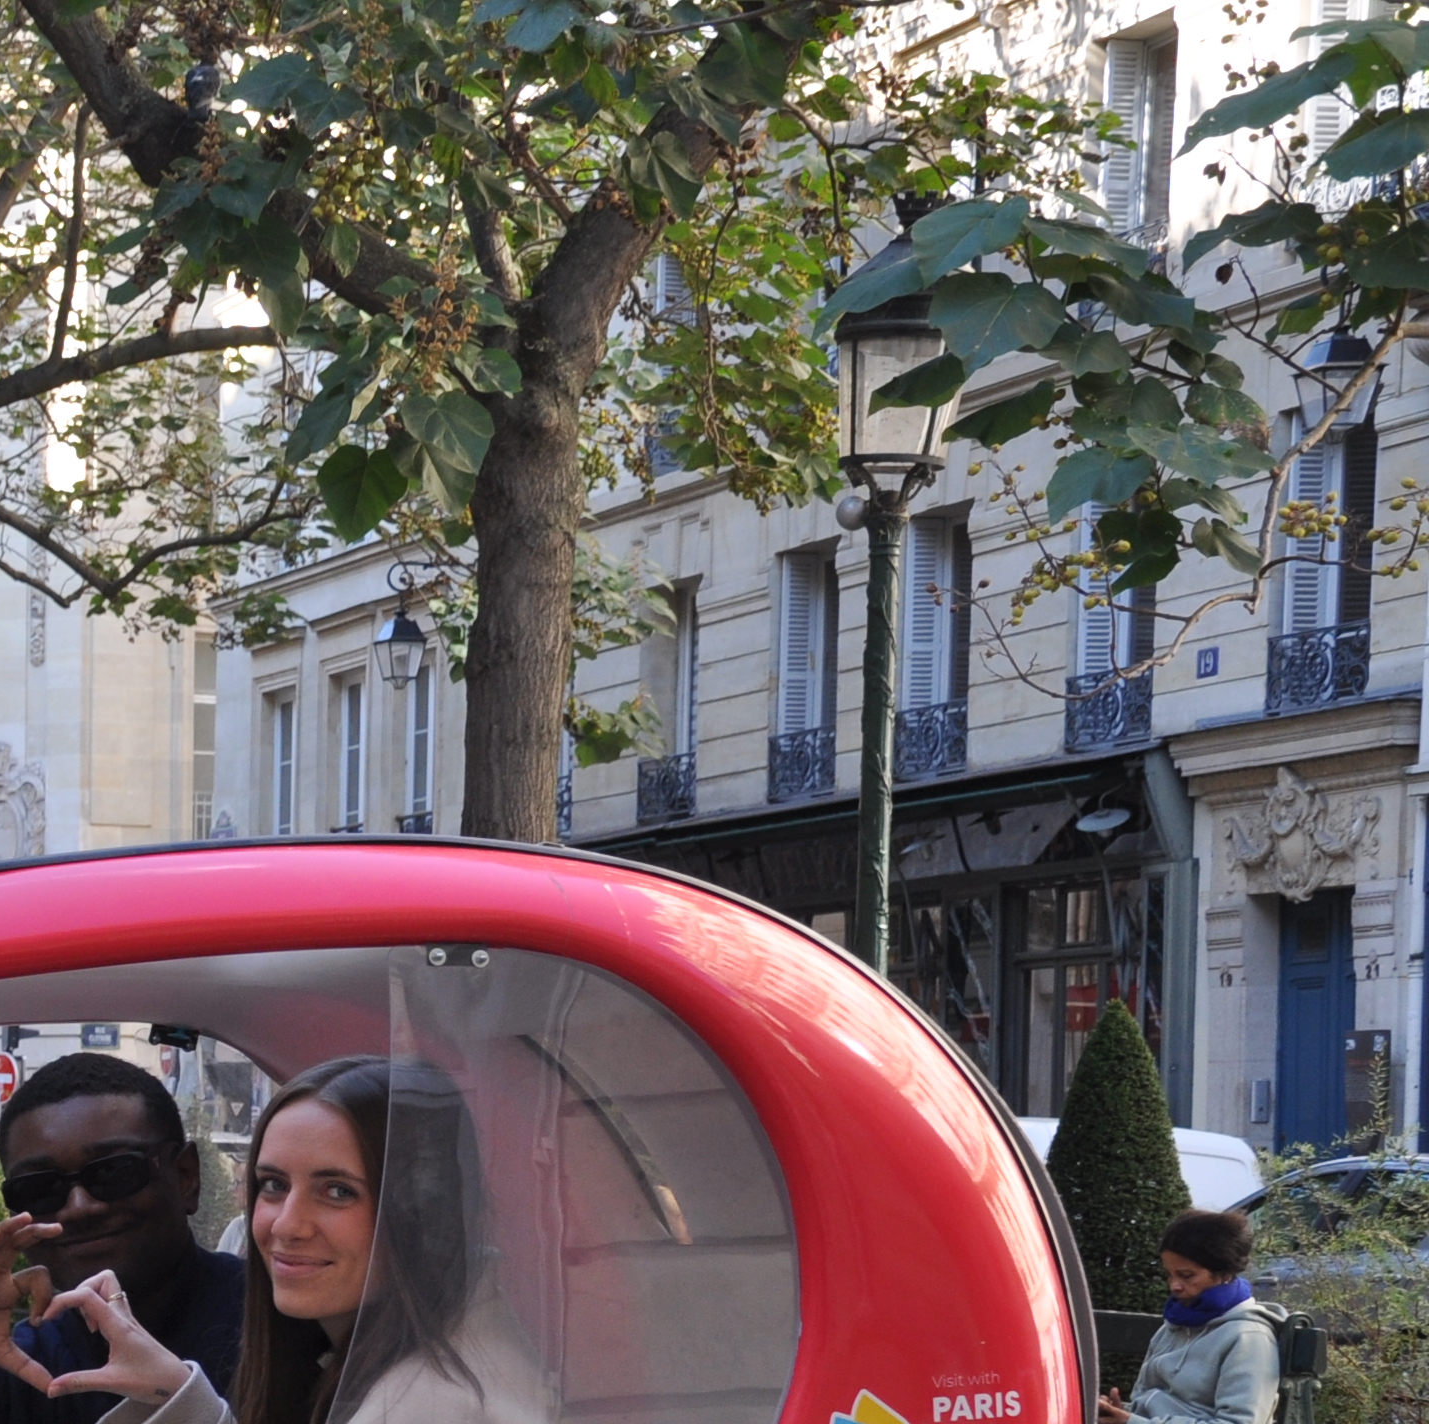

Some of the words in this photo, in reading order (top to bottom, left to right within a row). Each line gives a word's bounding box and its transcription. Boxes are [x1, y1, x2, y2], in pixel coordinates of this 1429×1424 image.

[1199, 653, 1214, 676] 19
[1365, 963, 1380, 979] 21
[931, 1374, 964, 1388] Visit
[967, 1371, 1001, 1386] with
[932, 1390, 1022, 1423] PARIS
